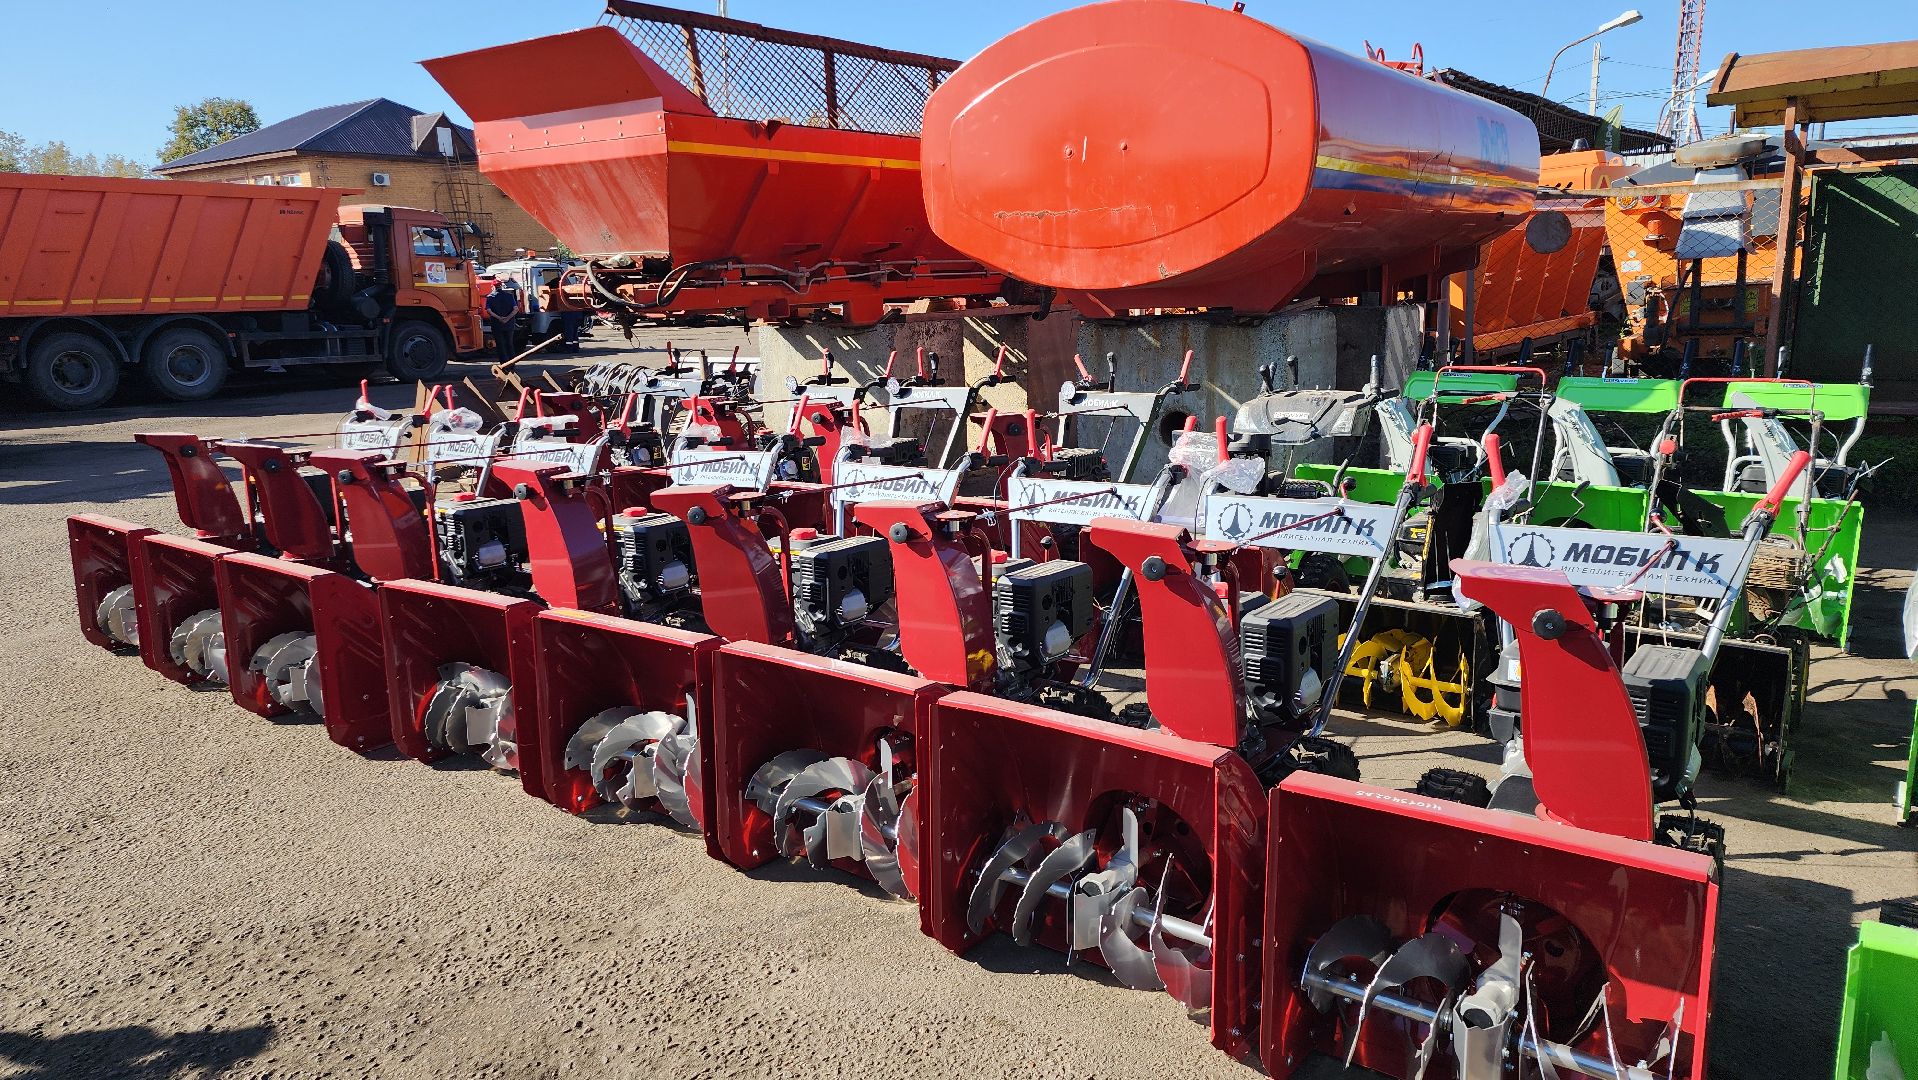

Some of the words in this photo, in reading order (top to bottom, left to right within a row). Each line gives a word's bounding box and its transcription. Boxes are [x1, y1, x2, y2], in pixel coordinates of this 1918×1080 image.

[701, 462, 748, 479] МОБИЛ
[869, 475, 927, 494] МОБИЛ
[1052, 490, 1122, 510] МОБИЛ
[1123, 495, 1141, 510] К
[1259, 511, 1351, 535] МОБИЛ
[1355, 518, 1376, 536] К
[1563, 542, 1690, 570] МОБИЛ
[1694, 552, 1724, 574] К
[1561, 565, 1663, 580] ИНТЕЛЛИГЕНАЯ
[1669, 574, 1722, 586] ТЕХНИКА
